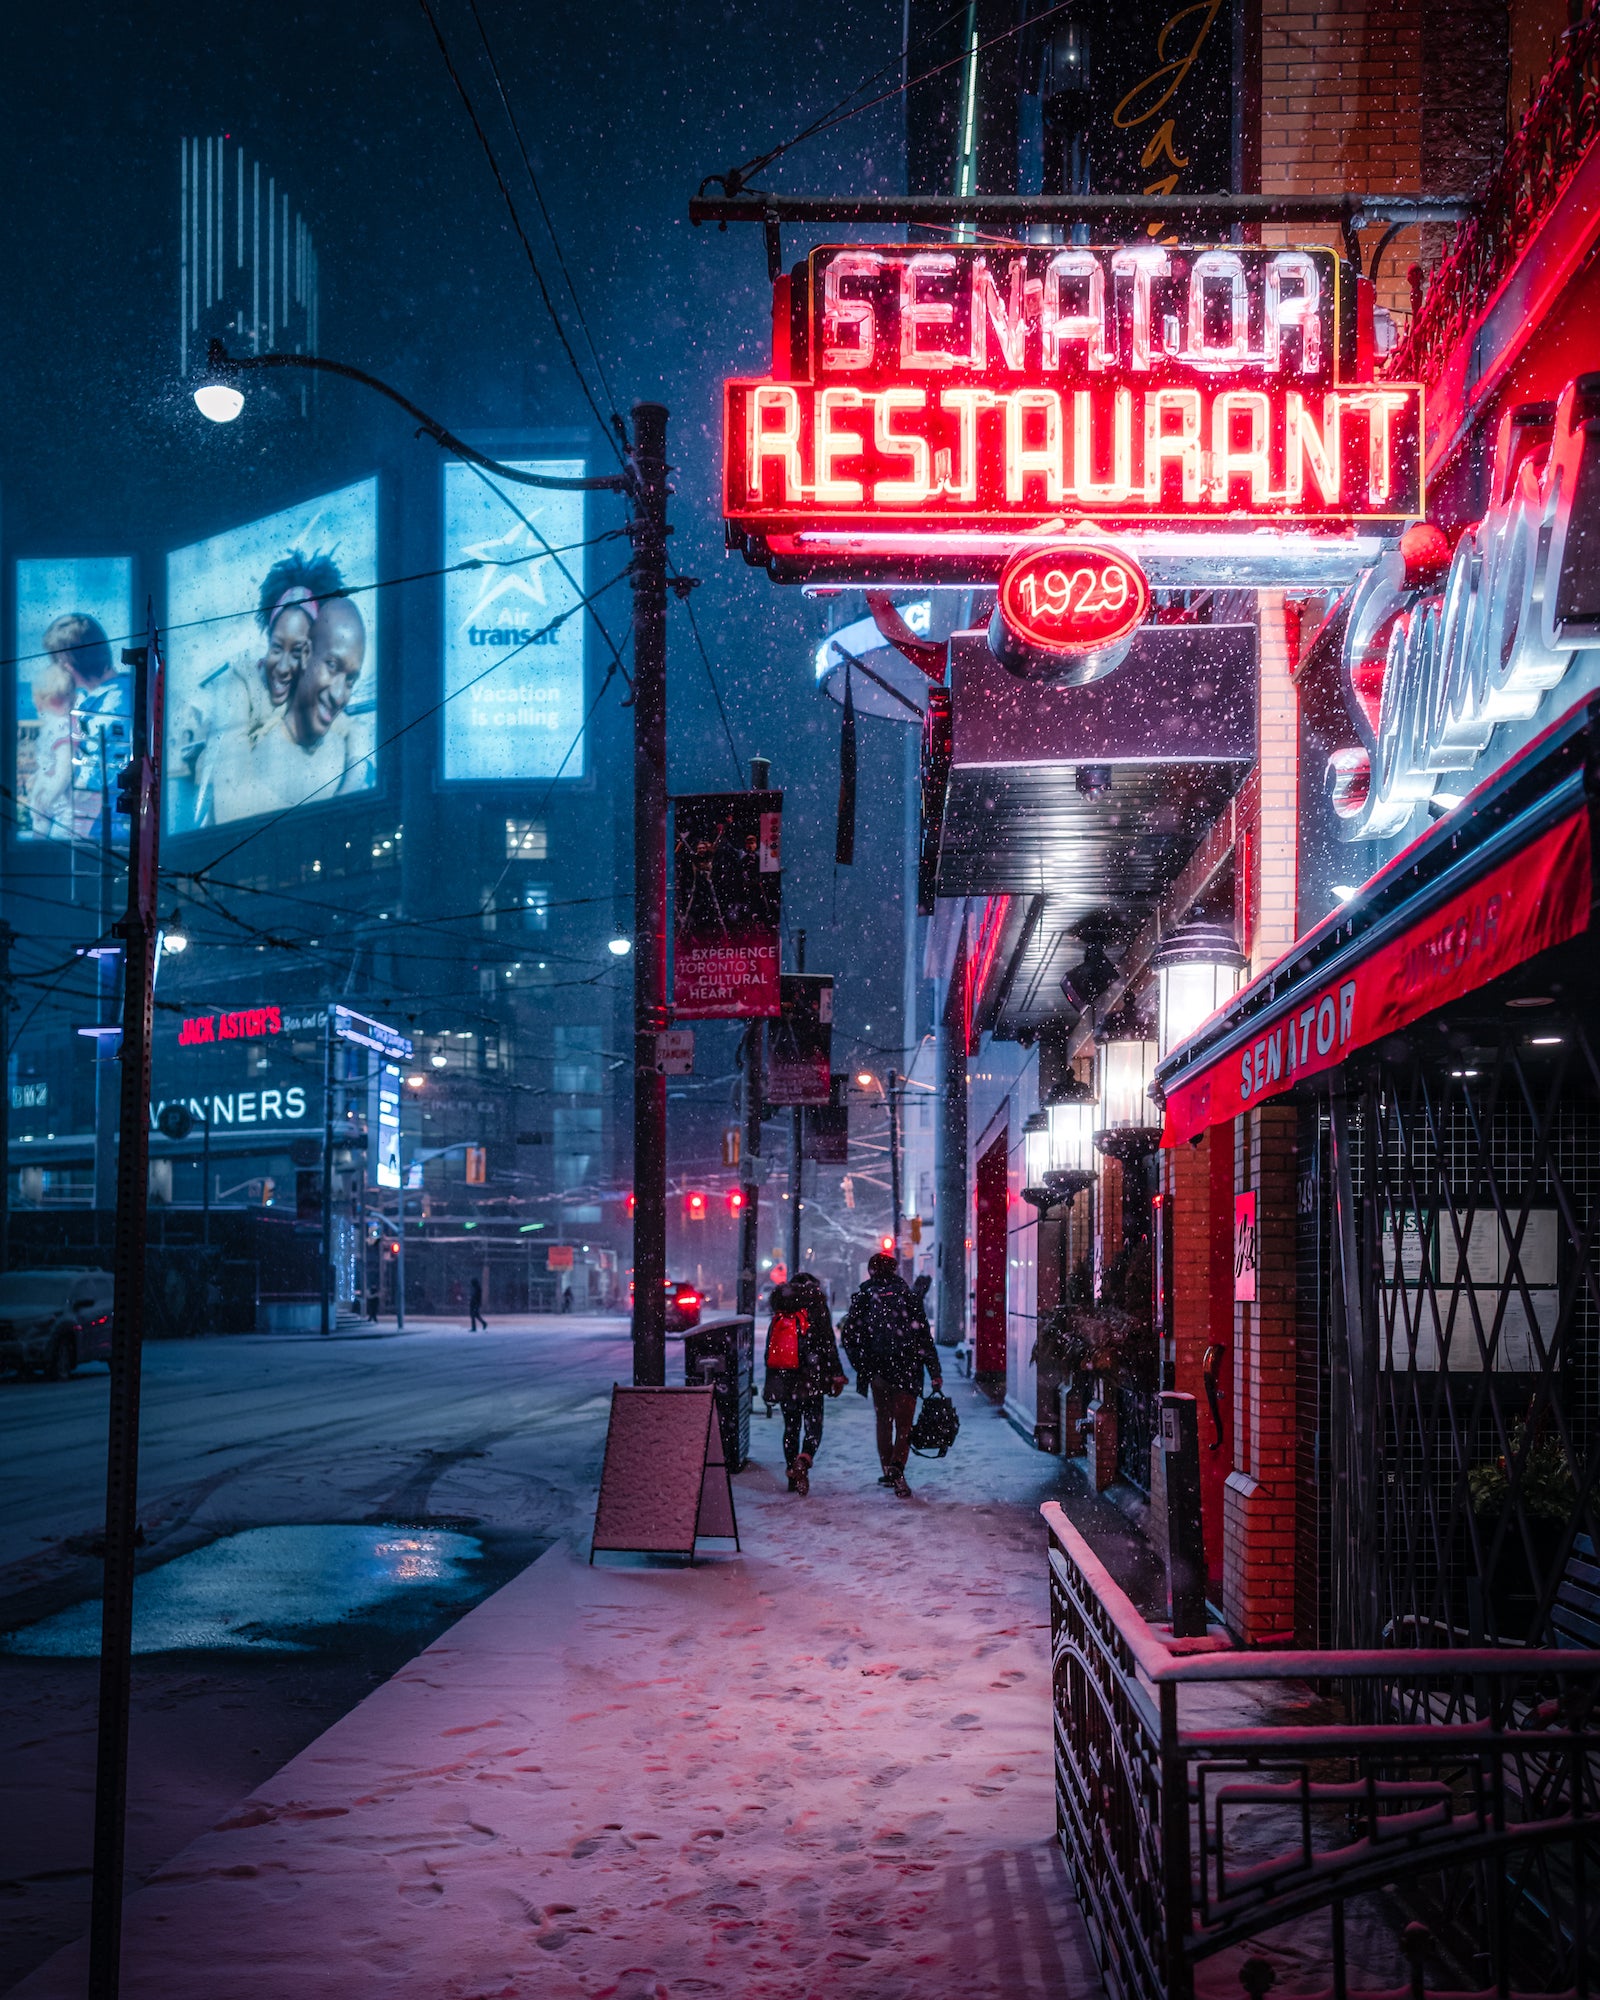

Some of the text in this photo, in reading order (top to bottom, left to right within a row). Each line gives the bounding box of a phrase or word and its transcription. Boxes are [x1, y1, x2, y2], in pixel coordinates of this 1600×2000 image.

[1113, 0, 1221, 245] Jaz
[822, 246, 1322, 373] SENATOR
[745, 384, 1410, 504] RESTAURANT
[1018, 565, 1130, 617] 1929
[498, 607, 530, 626] Air
[468, 624, 560, 646] transat
[470, 683, 561, 702] Vacation
[471, 708, 560, 730] is calling
[692, 945, 777, 961] EXPERIENCE
[680, 959, 757, 974] TORONTO'S
[699, 972, 768, 987] CULTURAL
[689, 986, 734, 999] HEART
[178, 1015, 215, 1047] JACK
[217, 1005, 282, 1041] ASTOR'S
[1239, 980, 1357, 1101] SENATOR
[148, 1086, 306, 1130] WNNERS
